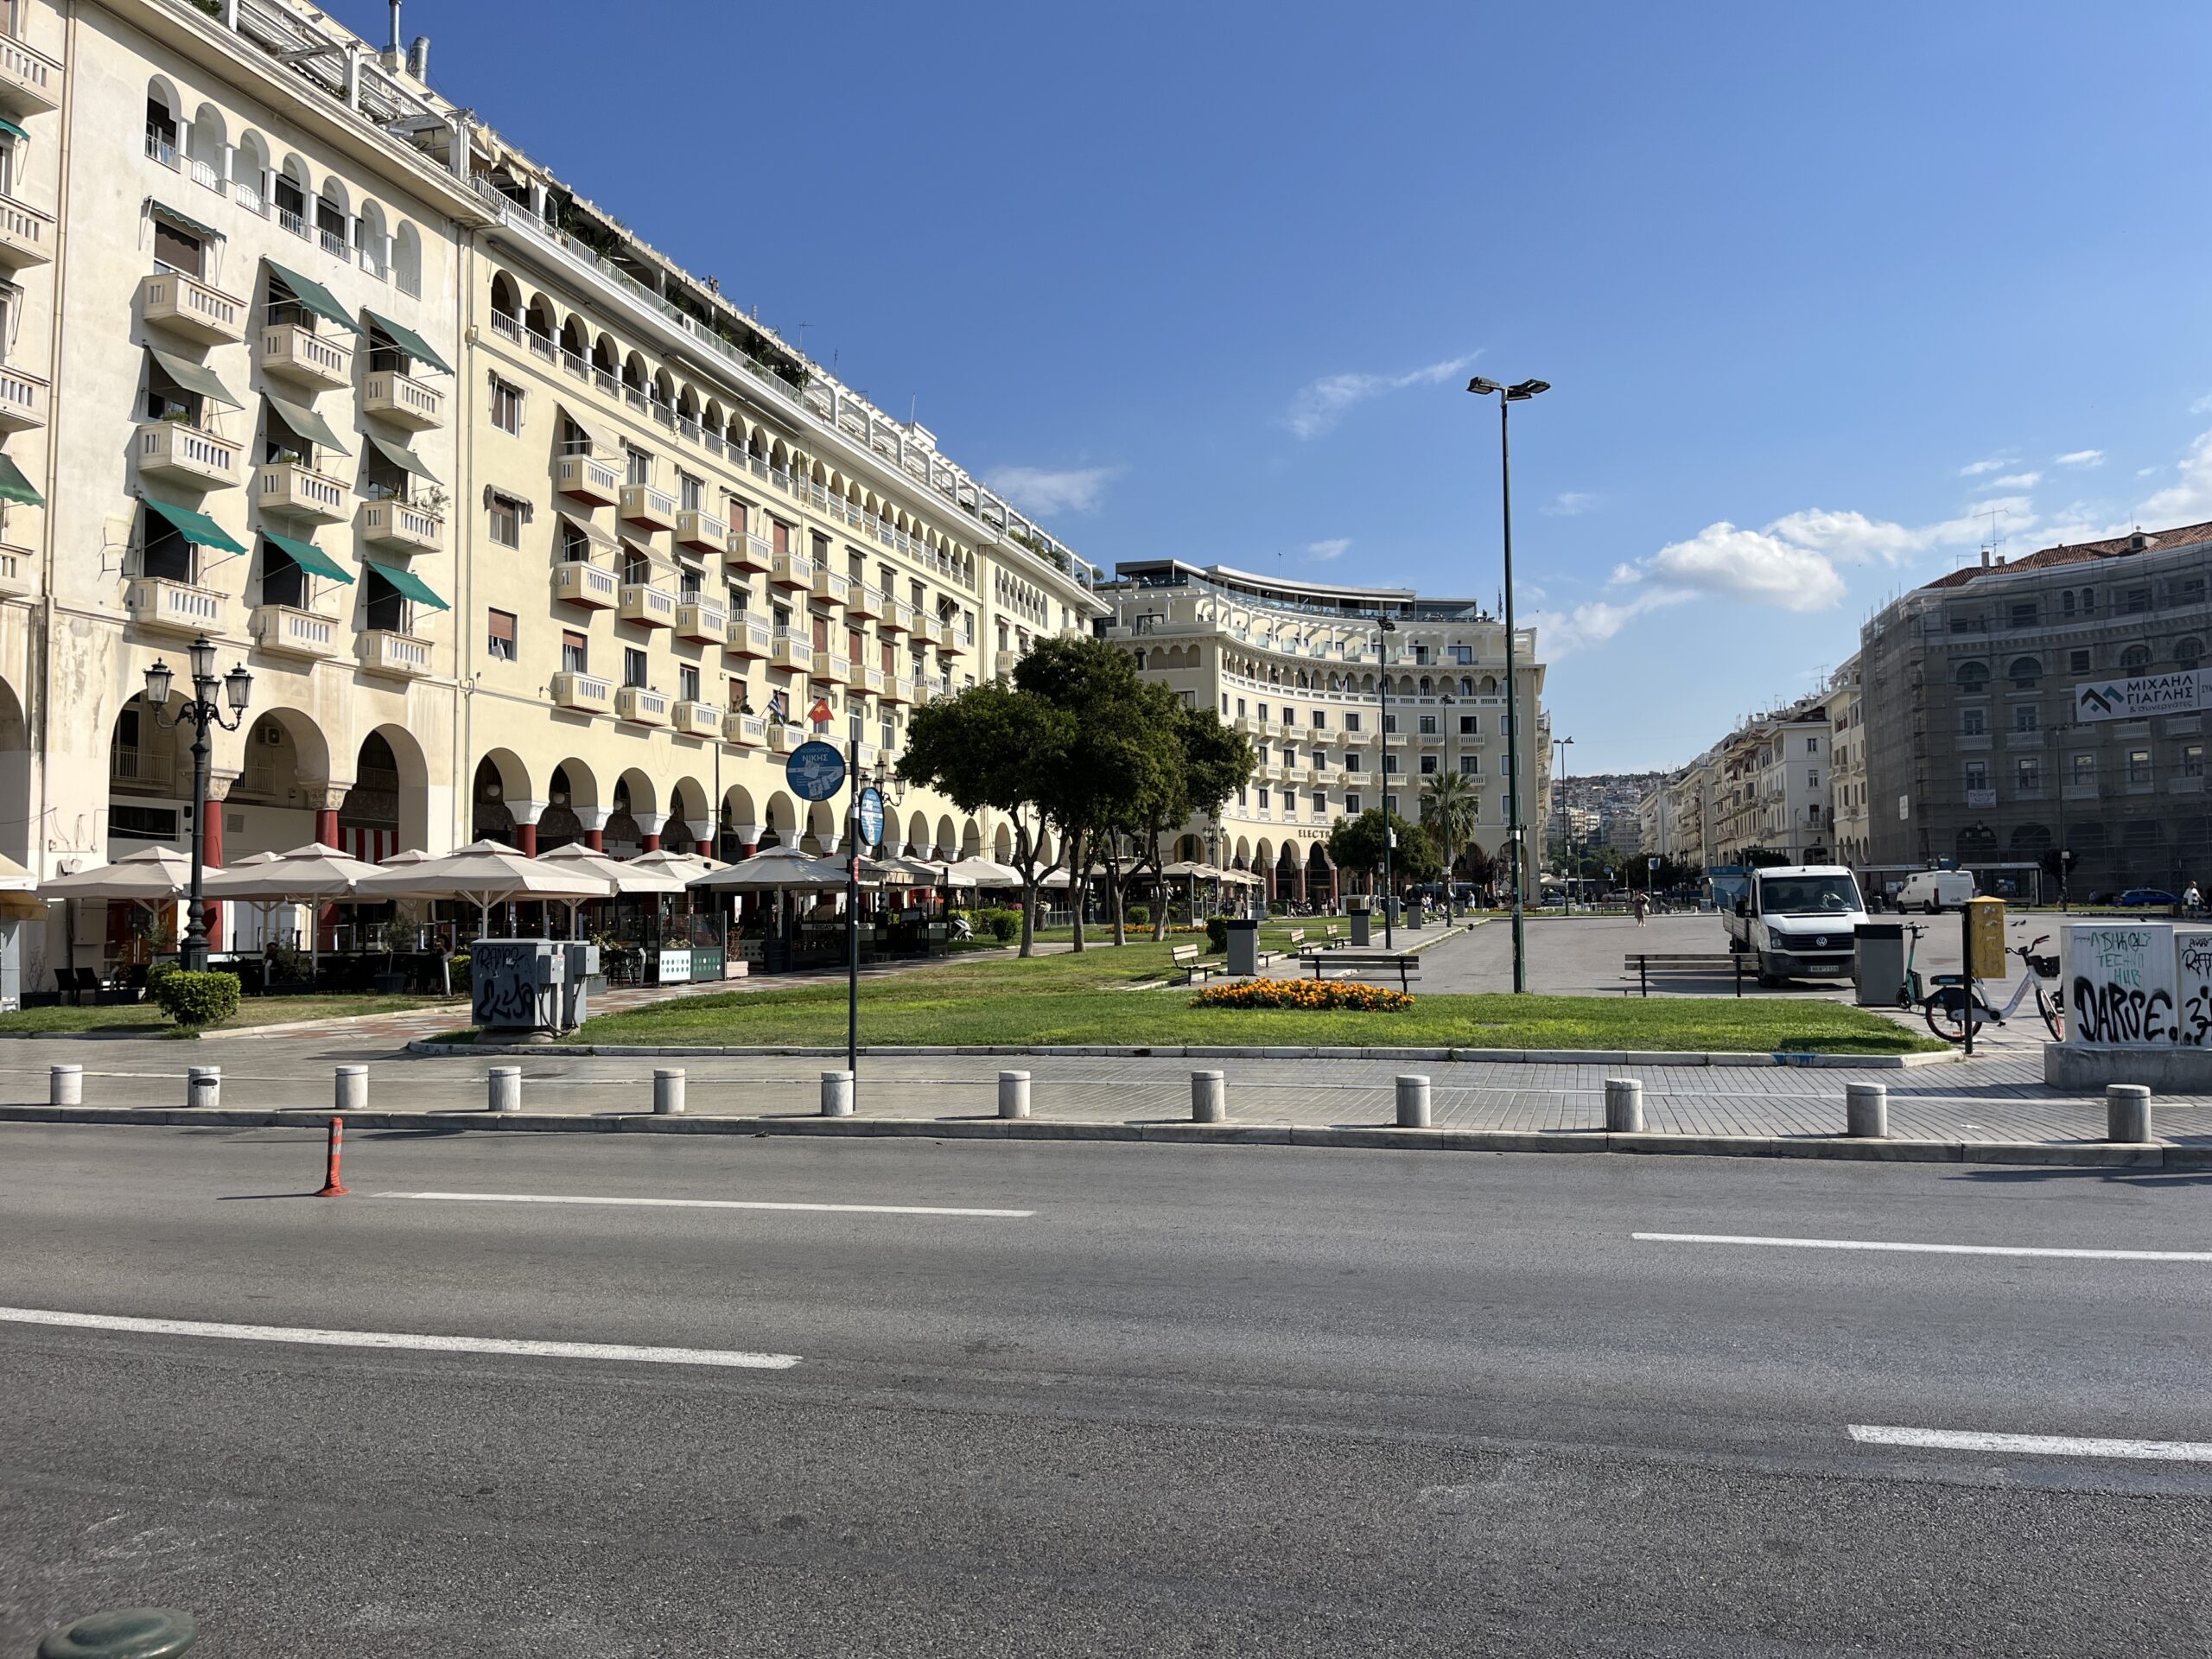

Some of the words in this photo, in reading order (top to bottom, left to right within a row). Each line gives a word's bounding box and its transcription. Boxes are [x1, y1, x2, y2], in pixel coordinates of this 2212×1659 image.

[2126, 674, 2193, 692] ΜΙΧΑΗΛ
[2126, 686, 2193, 705] ΓΙΑΓΛΗΣ
[2138, 700, 2193, 713] συνεργάτες
[802, 753, 829, 762] ΝΙΚΗΣ
